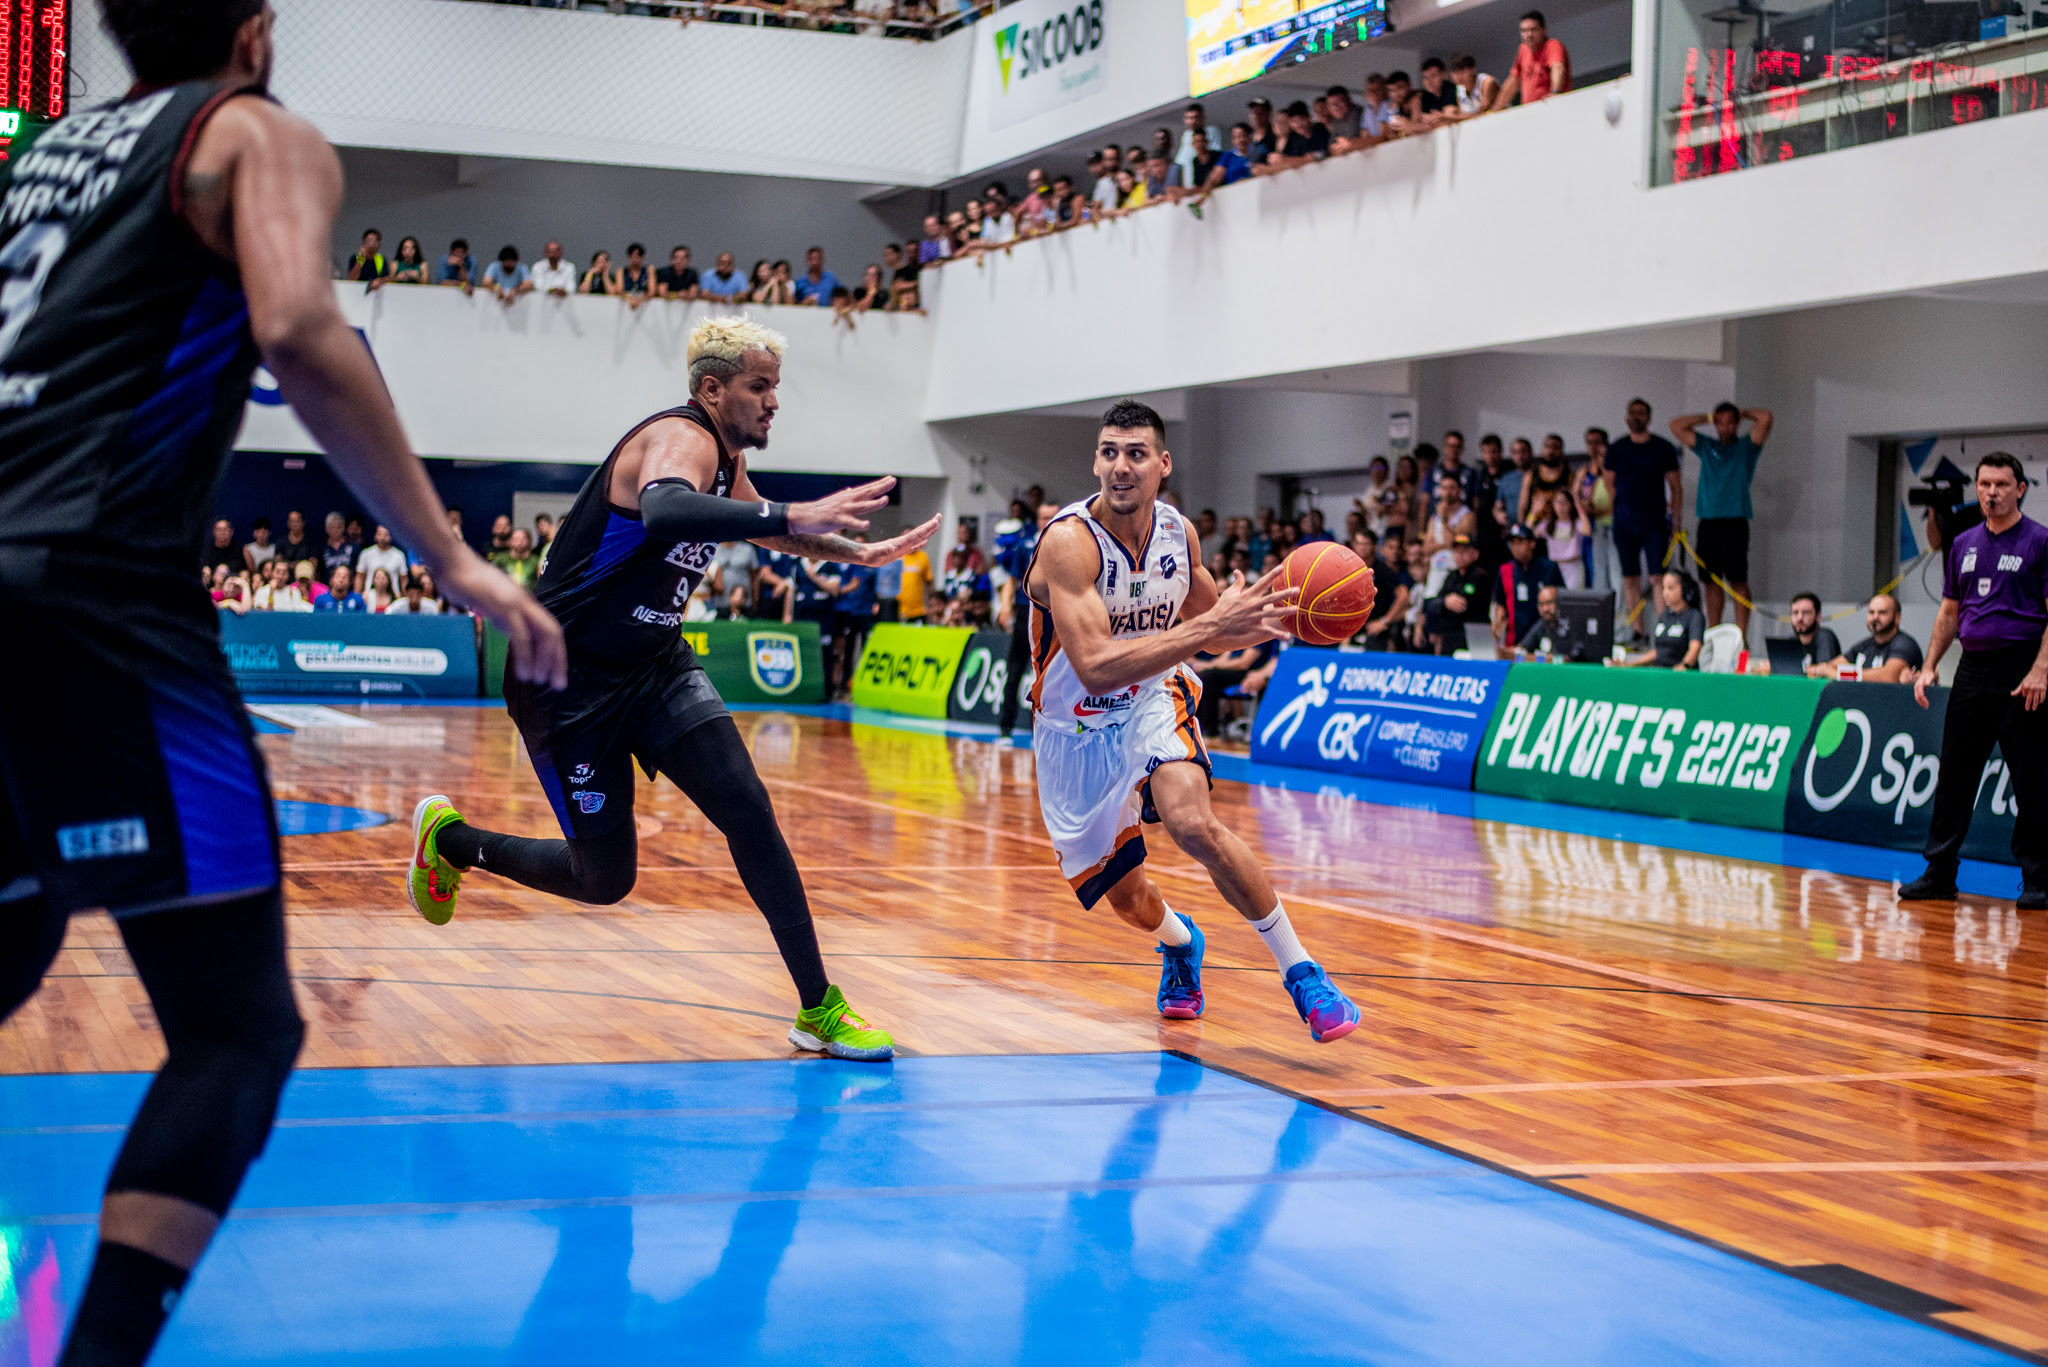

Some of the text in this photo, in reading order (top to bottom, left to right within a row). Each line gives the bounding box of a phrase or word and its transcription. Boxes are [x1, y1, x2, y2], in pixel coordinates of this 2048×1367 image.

[1019, 0, 1102, 79] SICOOB
[673, 576, 691, 608] 9
[860, 650, 951, 692] PENALTY
[1338, 666, 1490, 705] FORMAÇÃO DE ATLETAS
[1378, 719, 1469, 751] COMITÊ BRASILEIRO
[1487, 692, 1791, 791] PLAYOFFS 22/23
[1401, 745, 1441, 772] CLUBES
